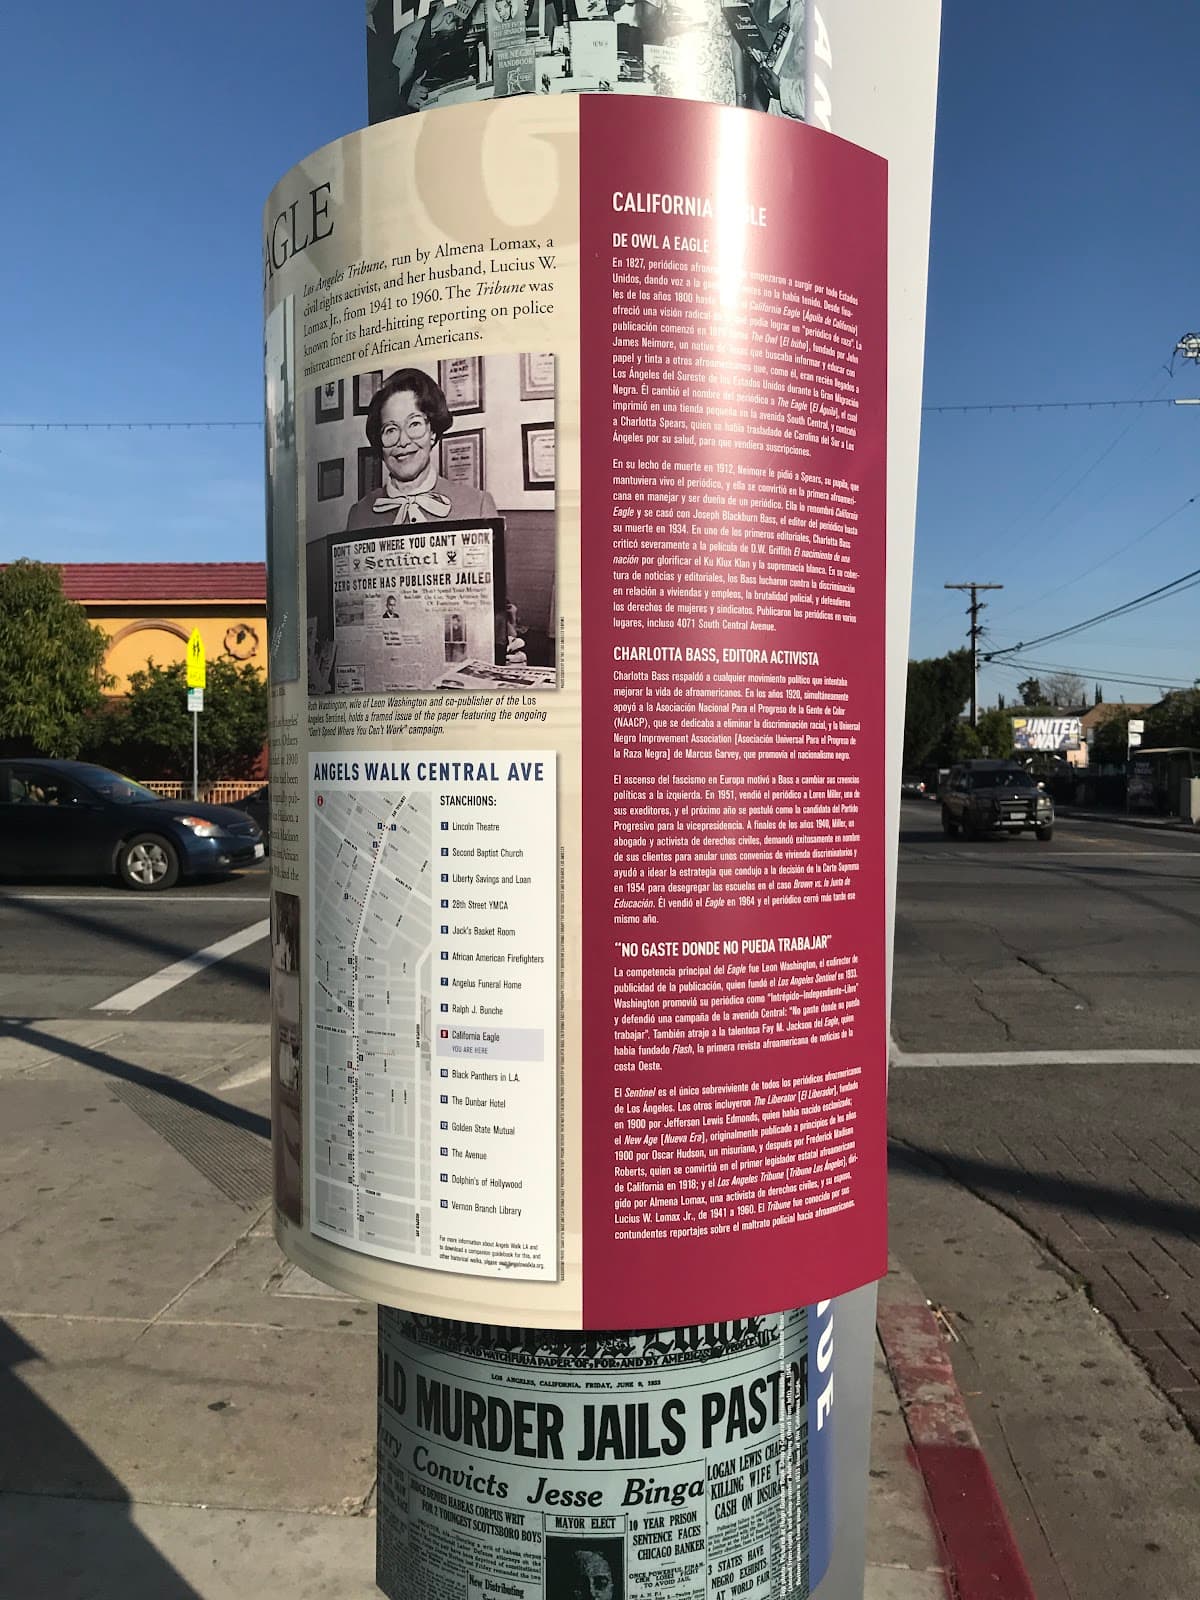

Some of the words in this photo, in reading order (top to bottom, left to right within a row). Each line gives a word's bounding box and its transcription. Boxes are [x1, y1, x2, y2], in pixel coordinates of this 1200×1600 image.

[612, 192, 713, 218] CALIFORNIA
[612, 233, 628, 247] DE
[631, 234, 659, 249] OWL
[662, 236, 671, 249] A
[674, 238, 709, 252] EAGLE
[314, 270, 345, 294] Angeles
[347, 260, 387, 280] Tribune,
[392, 255, 411, 266] run
[416, 248, 430, 263] by
[434, 243, 484, 259] Almena
[490, 238, 541, 251] Lomax,
[546, 238, 553, 248] a
[612, 258, 622, 267] En
[626, 258, 646, 269] 1827,
[649, 259, 688, 272] periódicos
[320, 293, 343, 313] rights
[344, 283, 381, 301] activist,
[383, 276, 404, 289] and
[407, 271, 425, 285] her
[428, 262, 486, 280] husband,
[490, 259, 535, 273] Lucius
[538, 255, 556, 270] W.
[328, 314, 342, 331] Jr.,
[343, 306, 366, 323] from
[369, 299, 392, 314] 1941
[396, 297, 408, 307] to
[411, 290, 443, 306] 1960.
[445, 285, 471, 299] The
[476, 281, 526, 296] Tribune
[529, 282, 553, 292] was
[330, 331, 343, 347] for
[345, 328, 356, 342] its
[359, 316, 425, 338] hard-hitting
[427, 306, 487, 330] reporting
[491, 305, 508, 316] on
[512, 300, 554, 316] police
[358, 345, 371, 359] of
[371, 338, 411, 356] African
[414, 330, 483, 349] Americans.
[354, 542, 376, 554] SPEND
[379, 539, 405, 551] WHERE
[409, 537, 426, 549] YOU
[430, 535, 456, 547] CAN'T
[364, 553, 438, 570] Sentinel
[353, 578, 377, 591] STORE
[380, 577, 396, 588] HAS
[400, 573, 451, 588] PUBLISHER
[455, 571, 491, 584] JAILED
[613, 618, 644, 629] lugares,
[647, 618, 674, 628] incluso
[677, 618, 695, 628] 4071
[698, 620, 720, 629] South
[722, 620, 747, 631] Central
[750, 622, 776, 632] Avenue.
[613, 647, 682, 662] CHARLOTTA
[686, 648, 720, 664] BASS,
[722, 649, 768, 664] EDITORA
[770, 651, 819, 666] ACTIVISTA
[370, 698, 385, 708] Leon
[387, 696, 427, 708] Washington
[429, 697, 443, 707] and
[445, 696, 492, 708] co-publisher
[495, 696, 504, 706] of
[507, 696, 519, 706] the
[522, 696, 536, 705] Los
[613, 718, 650, 729] (NAACP),
[1026, 719, 1081, 733] UNITED
[1032, 734, 1065, 749] WAY
[314, 763, 359, 781] ANGELS
[365, 763, 410, 781] WALK
[417, 762, 500, 781] CENTRAL
[507, 762, 544, 781] AVE
[440, 795, 496, 807] STANCHIONS:
[452, 822, 474, 831] Lincoln
[476, 823, 499, 831] Theatre
[452, 848, 474, 857] Second
[477, 848, 498, 858] Baptist
[501, 849, 523, 858] Church
[452, 874, 473, 884] Liberty
[476, 875, 499, 885] Savings
[502, 876, 513, 884] and
[516, 875, 531, 884] Loan
[614, 914, 639, 924] mismo
[643, 914, 658, 924] año.
[641, 942, 679, 956] GASTE
[682, 941, 720, 956] DONDE
[723, 940, 739, 955] NO
[742, 939, 775, 954] PUEDA
[452, 952, 473, 961] African
[476, 953, 505, 962] American
[508, 954, 544, 964] Firefighters
[452, 1031, 481, 1042] California
[483, 1032, 500, 1042] Eagle
[614, 1062, 635, 1071] costa
[639, 1061, 662, 1071] Oeste.
[452, 1070, 469, 1080] Black
[471, 1071, 498, 1081] Panthers
[500, 1072, 506, 1081] in
[508, 1073, 520, 1082] L.A.
[452, 1148, 462, 1159] The
[465, 1149, 487, 1160] Avenue
[615, 1151, 633, 1160] 1900
[636, 1152, 649, 1162] por
[652, 1150, 674, 1160] Oscar
[677, 1148, 706, 1159] Hudson,
[452, 1201, 473, 1212] Vernon
[475, 1203, 497, 1214] Branch
[500, 1204, 522, 1217] Library
[614, 1229, 667, 1240] contundentes
[670, 1226, 707, 1239] reportajes
[710, 1224, 730, 1234] sobre
[539, 1380, 581, 1388] CALIFORNIA,
[416, 1374, 564, 1460] MURDER
[578, 1399, 686, 1460] JAILS
[707, 1458, 736, 1481] LOGAN
[739, 1450, 762, 1473] LEWIS
[412, 1446, 509, 1498] Convicts
[527, 1477, 603, 1507] Jesse
[621, 1478, 705, 1506] Binga
[711, 1477, 744, 1501] KILLING
[750, 1463, 772, 1488] WIFE
[475, 1506, 503, 1521] CORPUS
[505, 1512, 525, 1526] WRIT
[556, 1517, 584, 1529] MAYOR
[591, 1517, 616, 1529] ELECT
[629, 1520, 638, 1531] 10
[643, 1515, 664, 1529] YEAR
[670, 1511, 697, 1527] PRISON
[473, 1518, 520, 1539] SCOTTSBORO
[522, 1530, 542, 1543] BOYS
[633, 1529, 672, 1545] SENTENCE
[678, 1526, 701, 1539] FACES
[638, 1545, 672, 1560] CHICAGO
[675, 1539, 704, 1556] BANKER
[718, 1554, 743, 1572] STATES
[748, 1545, 764, 1561] HAVE
[731, 1578, 754, 1599] WORLD
[756, 1570, 770, 1587] FAIR
